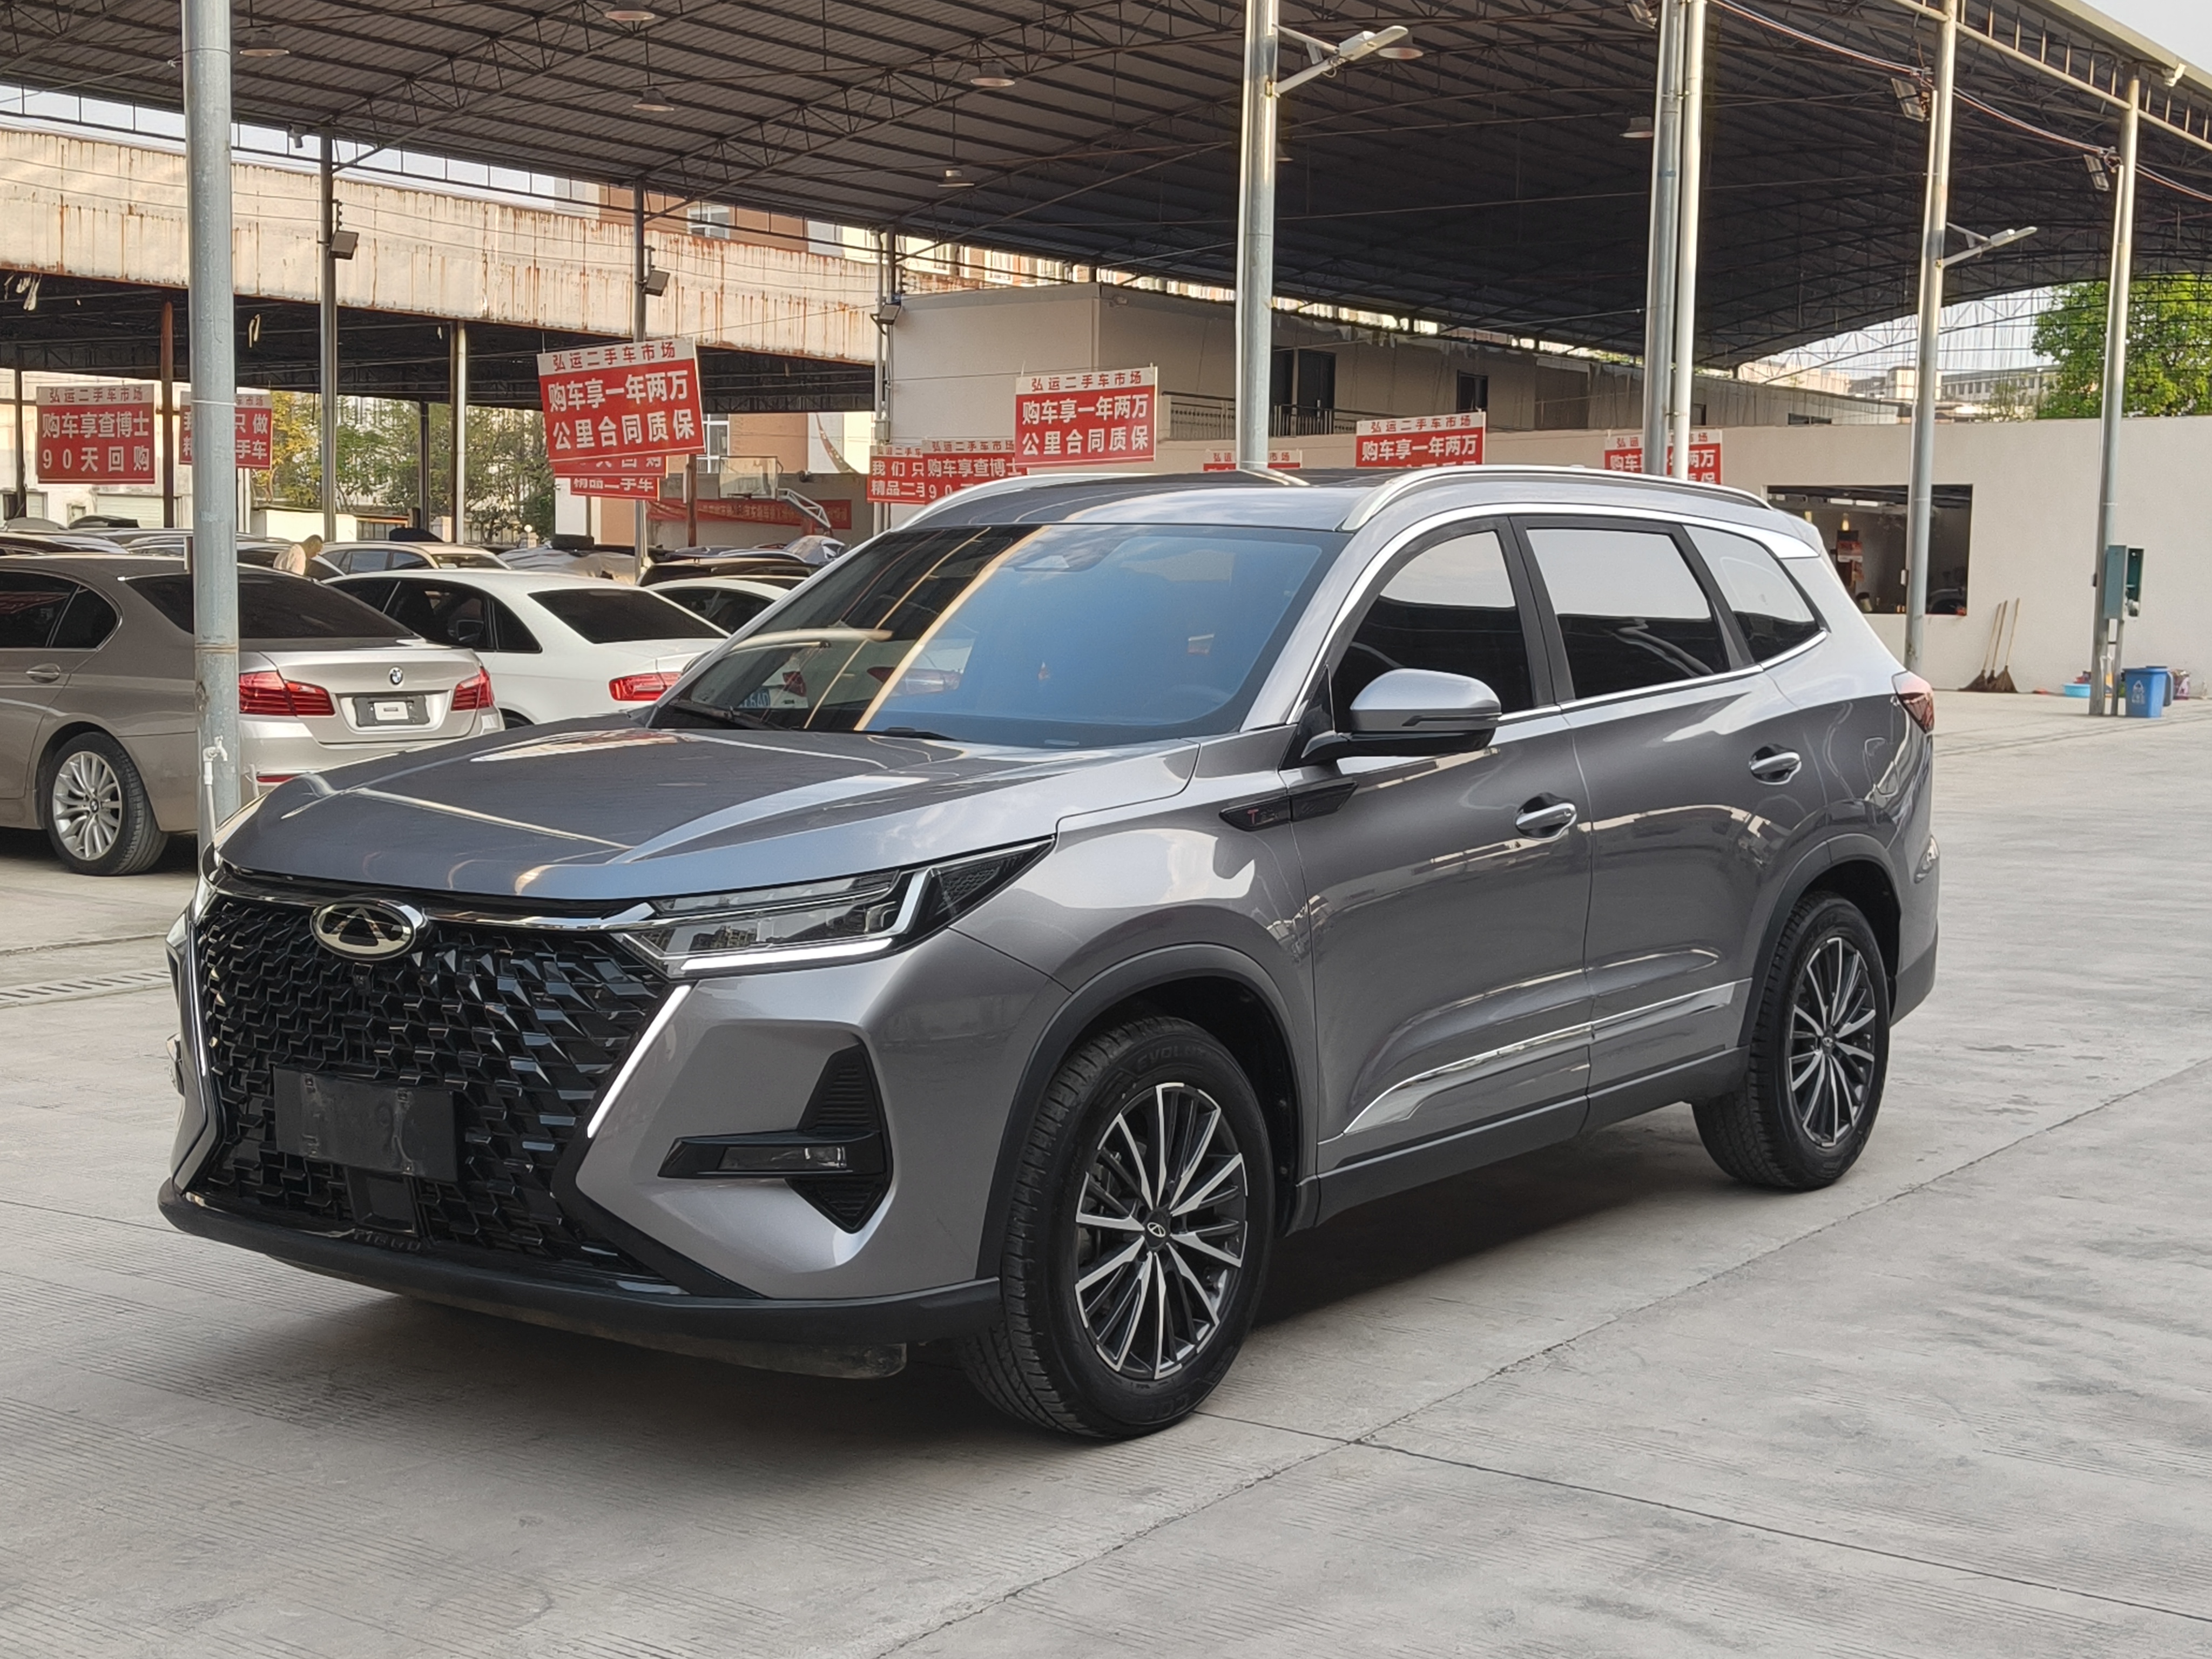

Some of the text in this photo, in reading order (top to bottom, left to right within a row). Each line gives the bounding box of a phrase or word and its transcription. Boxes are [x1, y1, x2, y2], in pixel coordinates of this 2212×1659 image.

[553, 341, 676, 371] 弘运二手车市场
[49, 387, 143, 403] 弘运二手车市场
[548, 370, 689, 413] 购车享一年两万
[1031, 370, 1141, 392] 弘运二手车市场
[1022, 393, 1149, 426] 购车享一年两万
[43, 410, 149, 438] 购车享查博士
[553, 408, 695, 451] 公里合同质保
[1371, 415, 1471, 433] 弘运二手车市场
[1022, 425, 1149, 456] 公里合同质保
[1362, 434, 1478, 461] 购车享一年两万
[43, 445, 150, 472] 90天回购
